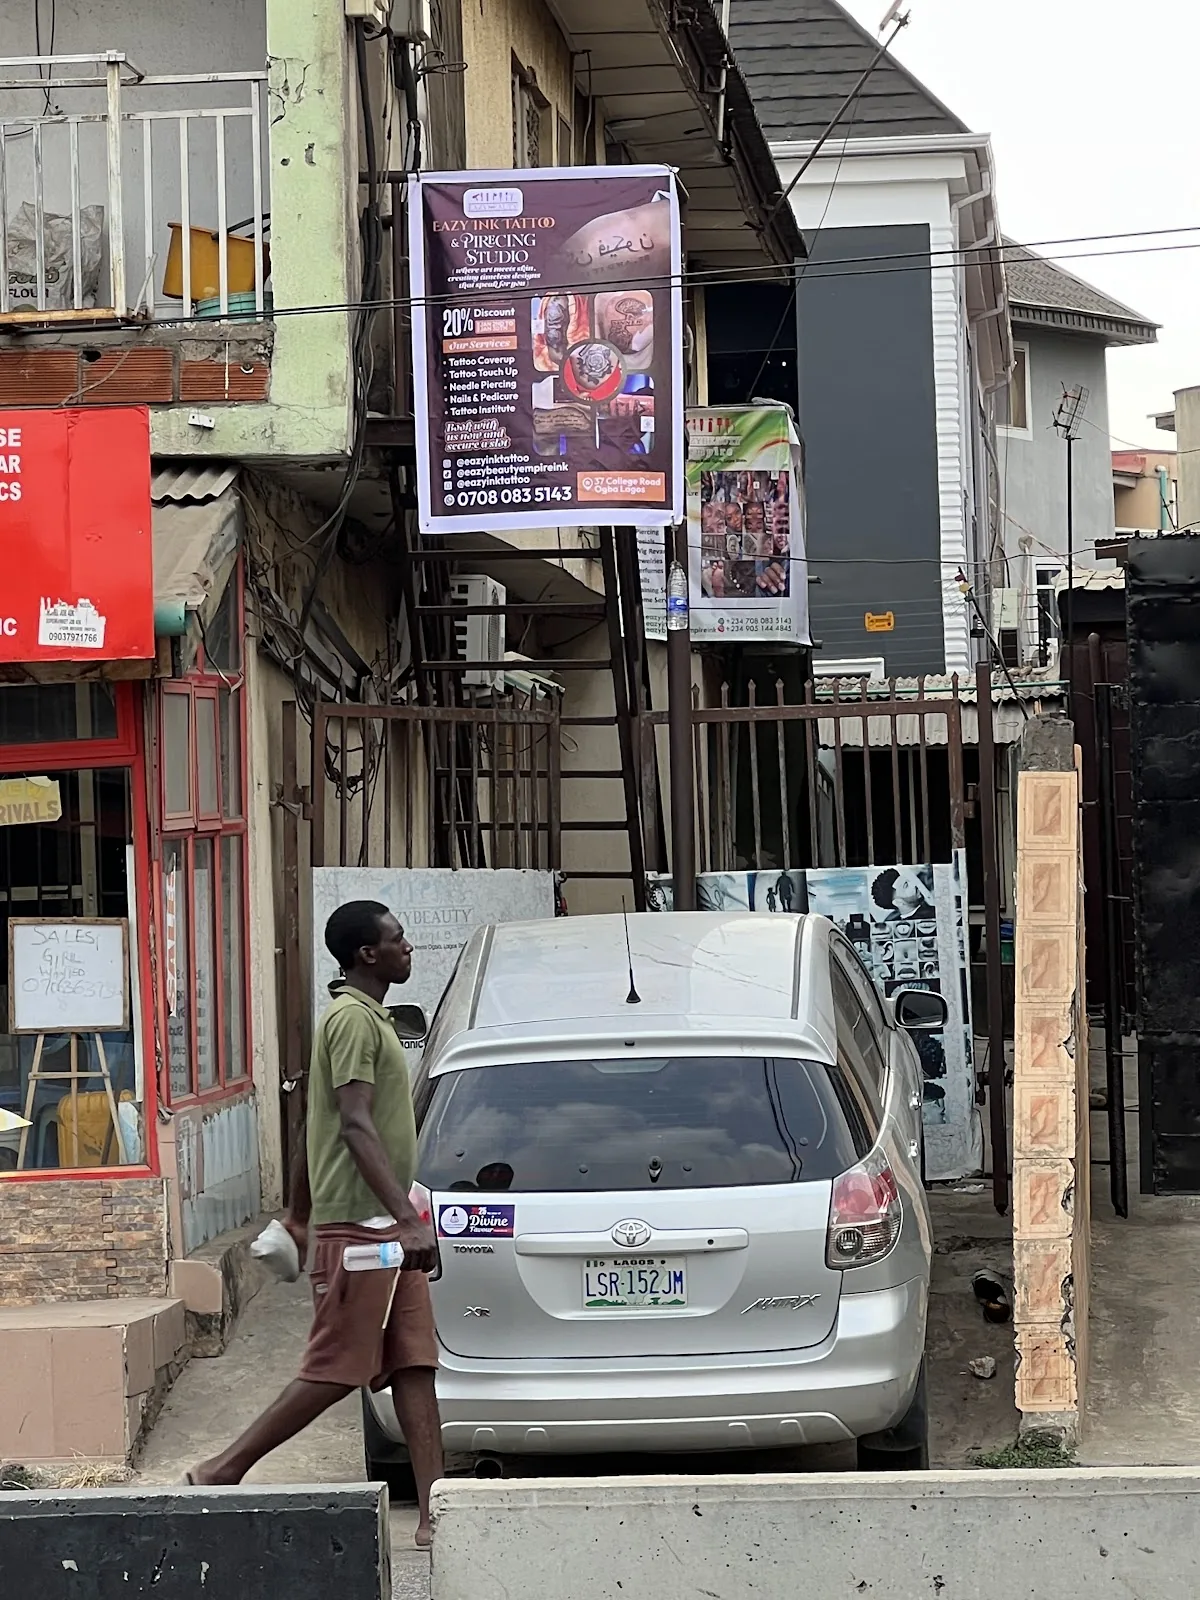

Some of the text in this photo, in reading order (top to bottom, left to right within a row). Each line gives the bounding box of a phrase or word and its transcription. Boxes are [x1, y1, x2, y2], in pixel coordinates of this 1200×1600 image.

[433, 216, 556, 232] EAZY INK TATTOO
[450, 238, 460, 248] &
[465, 249, 529, 266] STUDIO
[443, 307, 516, 336] 20% Discount
[449, 339, 511, 350] Our Services
[449, 356, 515, 367] Tattoo Coverup
[449, 367, 518, 379] Tattoo Touch Up
[449, 379, 517, 391] Needle Piercing
[450, 392, 519, 404] Nails & Pedicure
[450, 404, 516, 416] Tattoo Institute
[474, 420, 497, 431] with
[447, 428, 504, 441] us now and
[447, 441, 479, 451] secure
[490, 438, 510, 447] slot
[457, 453, 530, 468] @eazyinktattoo
[457, 462, 569, 477] @eazybeautyempireink
[457, 475, 530, 488] @eazyinktattoo
[594, 477, 661, 486] 37 College Road
[0, 481, 22, 501] CS
[457, 486, 572, 506] 0708 083 5143
[594, 485, 646, 495] Ogba Lagos
[469, 1214, 509, 1226] Divine
[453, 1244, 494, 1253] TOYOTA
[464, 1306, 491, 1317] XR
